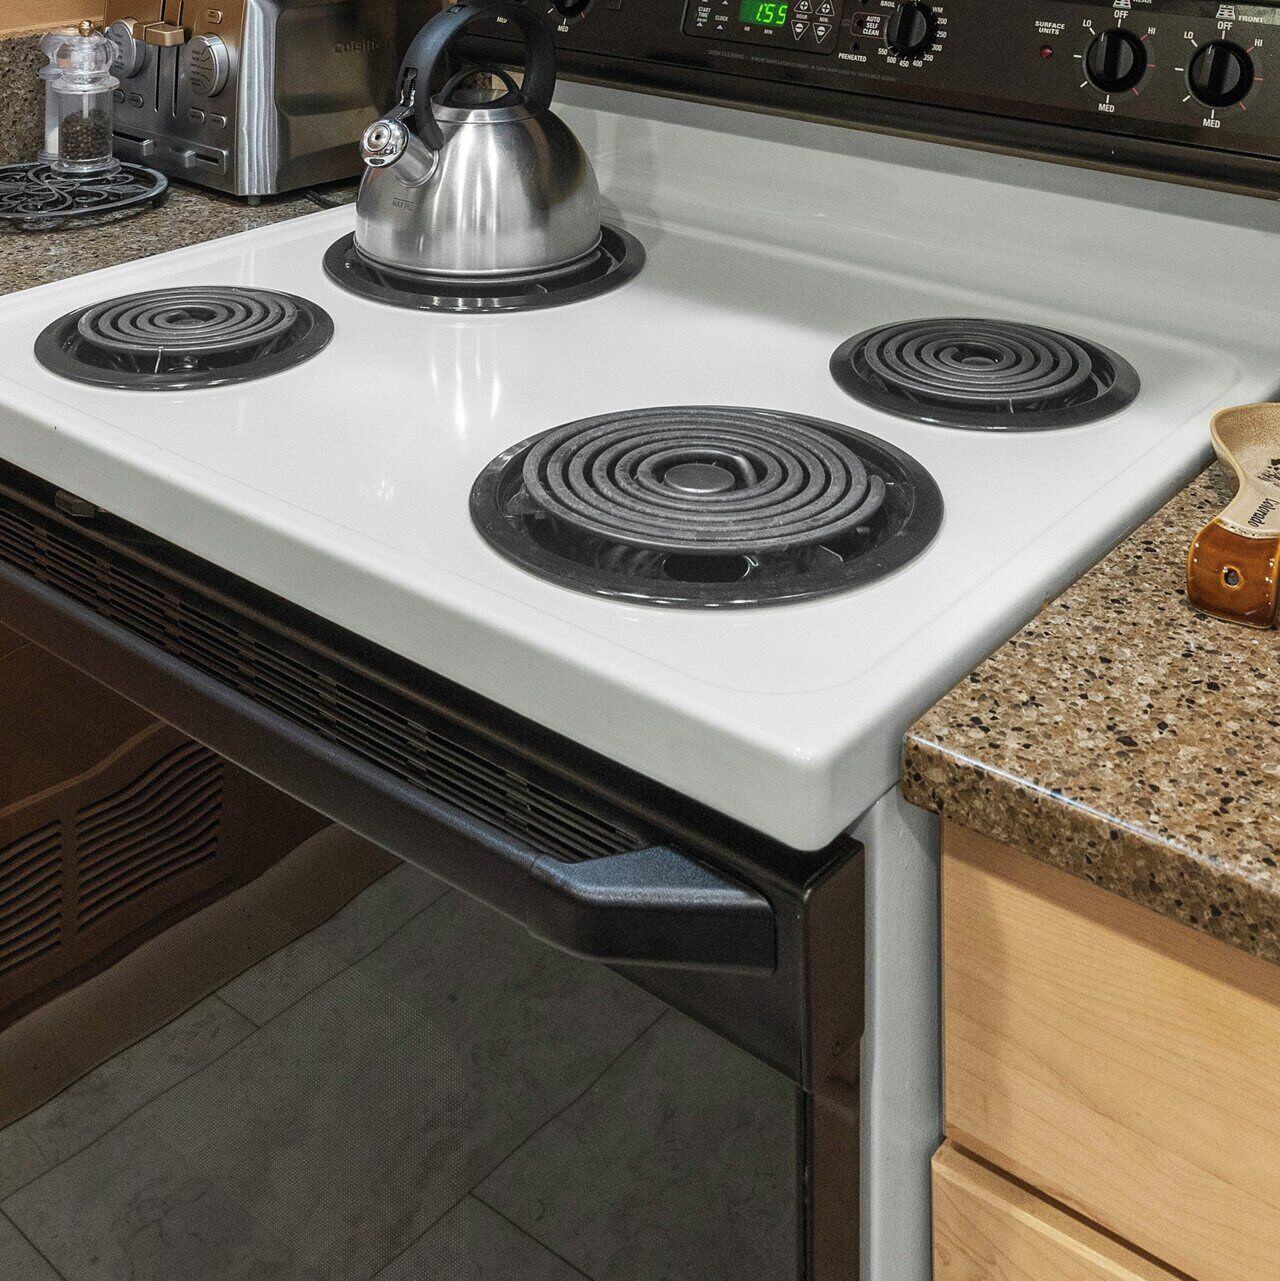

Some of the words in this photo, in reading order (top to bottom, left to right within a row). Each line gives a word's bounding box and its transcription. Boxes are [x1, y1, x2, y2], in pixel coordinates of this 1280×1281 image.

[880, 0, 895, 8] BROIL
[1114, 10, 1128, 19] OFF
[937, 17, 948, 25] 200
[1083, 19, 1092, 28] LO
[1035, 21, 1065, 30] SURFACE
[1218, 21, 1233, 30] OFF
[1148, 27, 1156, 35] HI
[1184, 31, 1193, 39] LO
[1254, 39, 1263, 47] HI
[878, 48, 888, 56] 550
[838, 53, 867, 62] PREHEATED
[887, 56, 896, 64] 500
[899, 60, 909, 68] 450
[1098, 103, 1115, 113] MED
[1202, 119, 1220, 128] MED
[1247, 498, 1280, 527] Colorado
